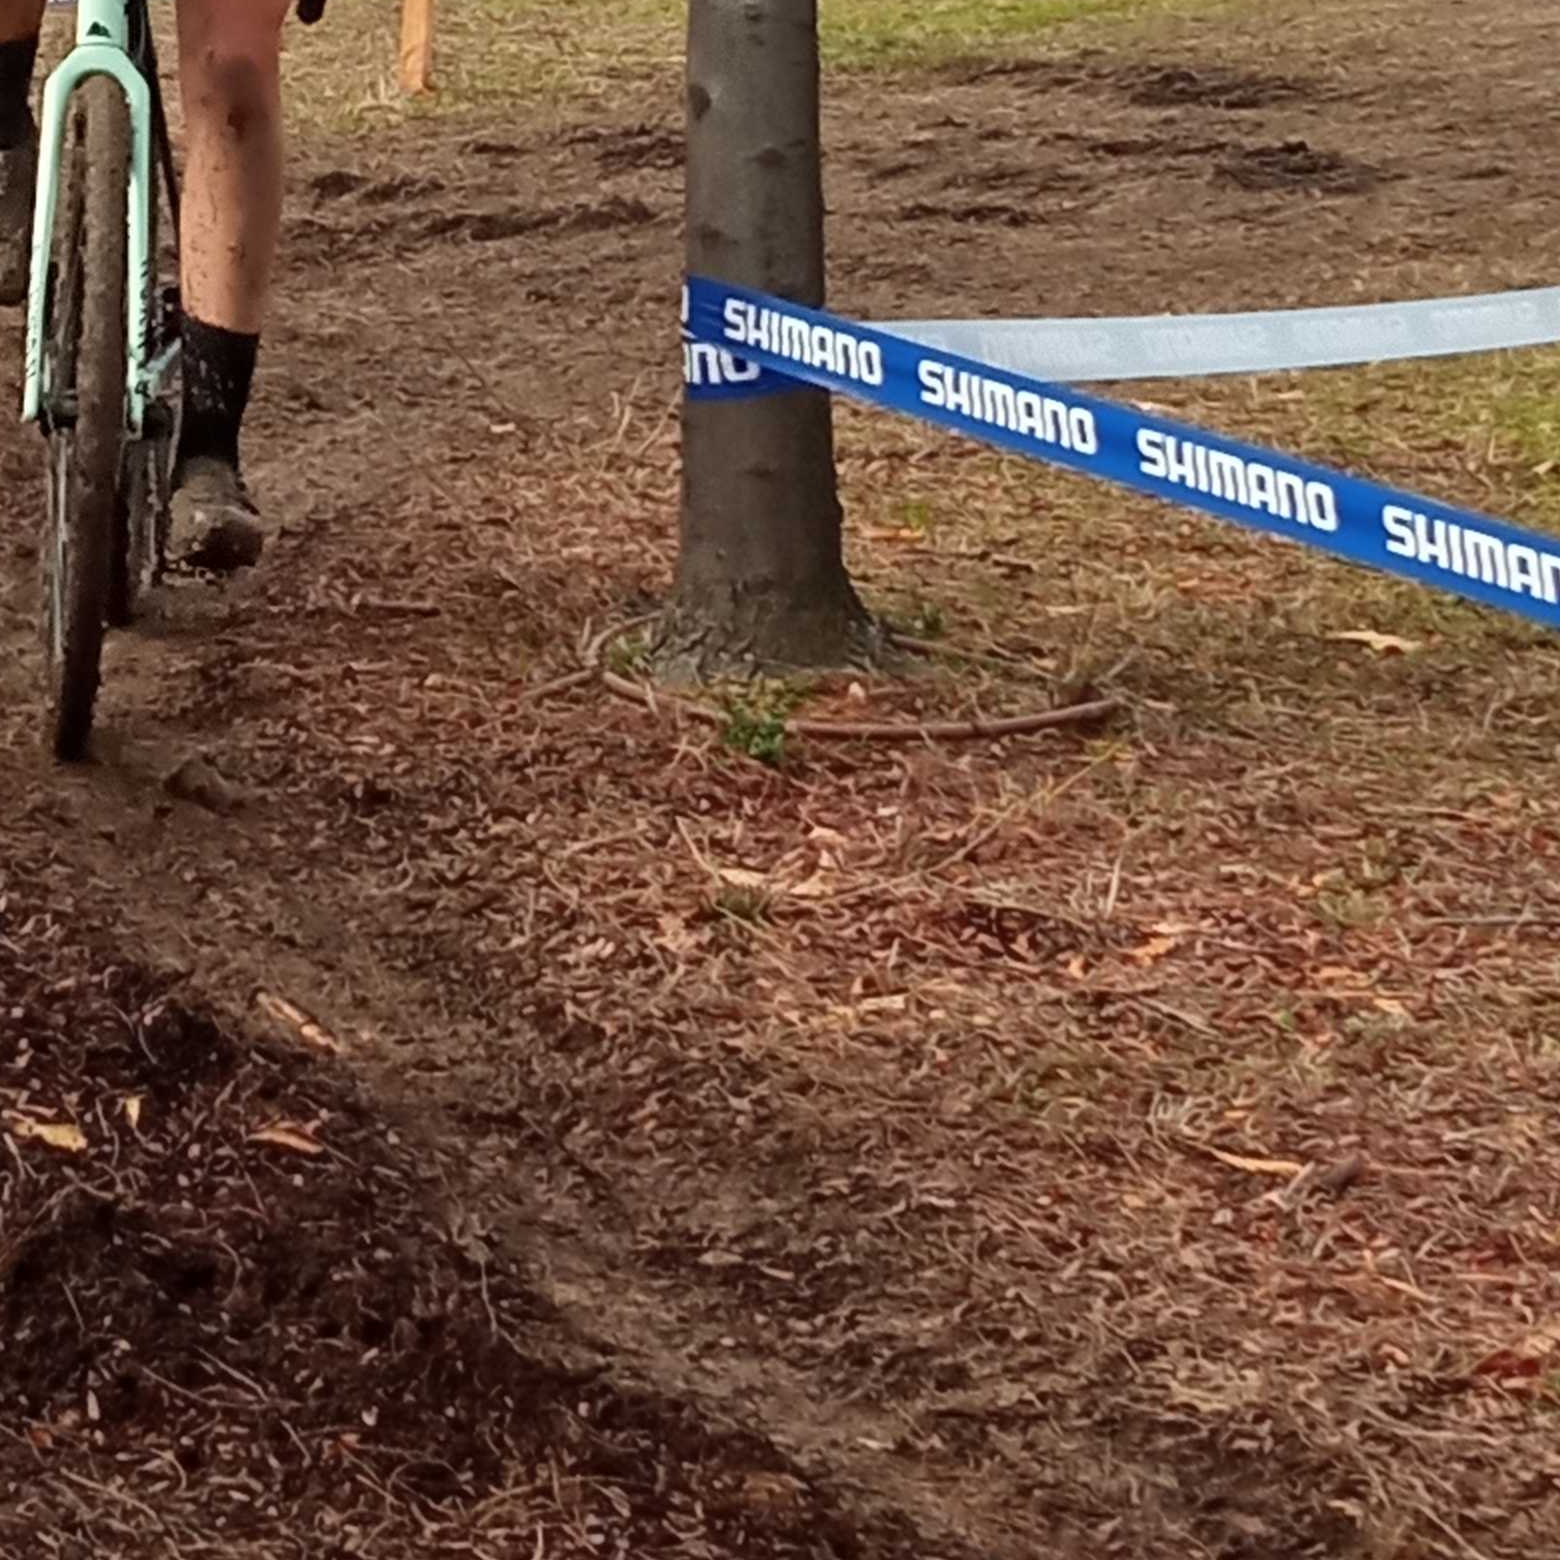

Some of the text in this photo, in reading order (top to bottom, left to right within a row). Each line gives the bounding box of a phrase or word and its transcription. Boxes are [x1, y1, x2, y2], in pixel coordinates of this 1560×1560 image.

[723, 297, 884, 387] SHIMANO
[917, 359, 1099, 456] SHIMANO
[1136, 427, 1339, 533] SHIMANO
